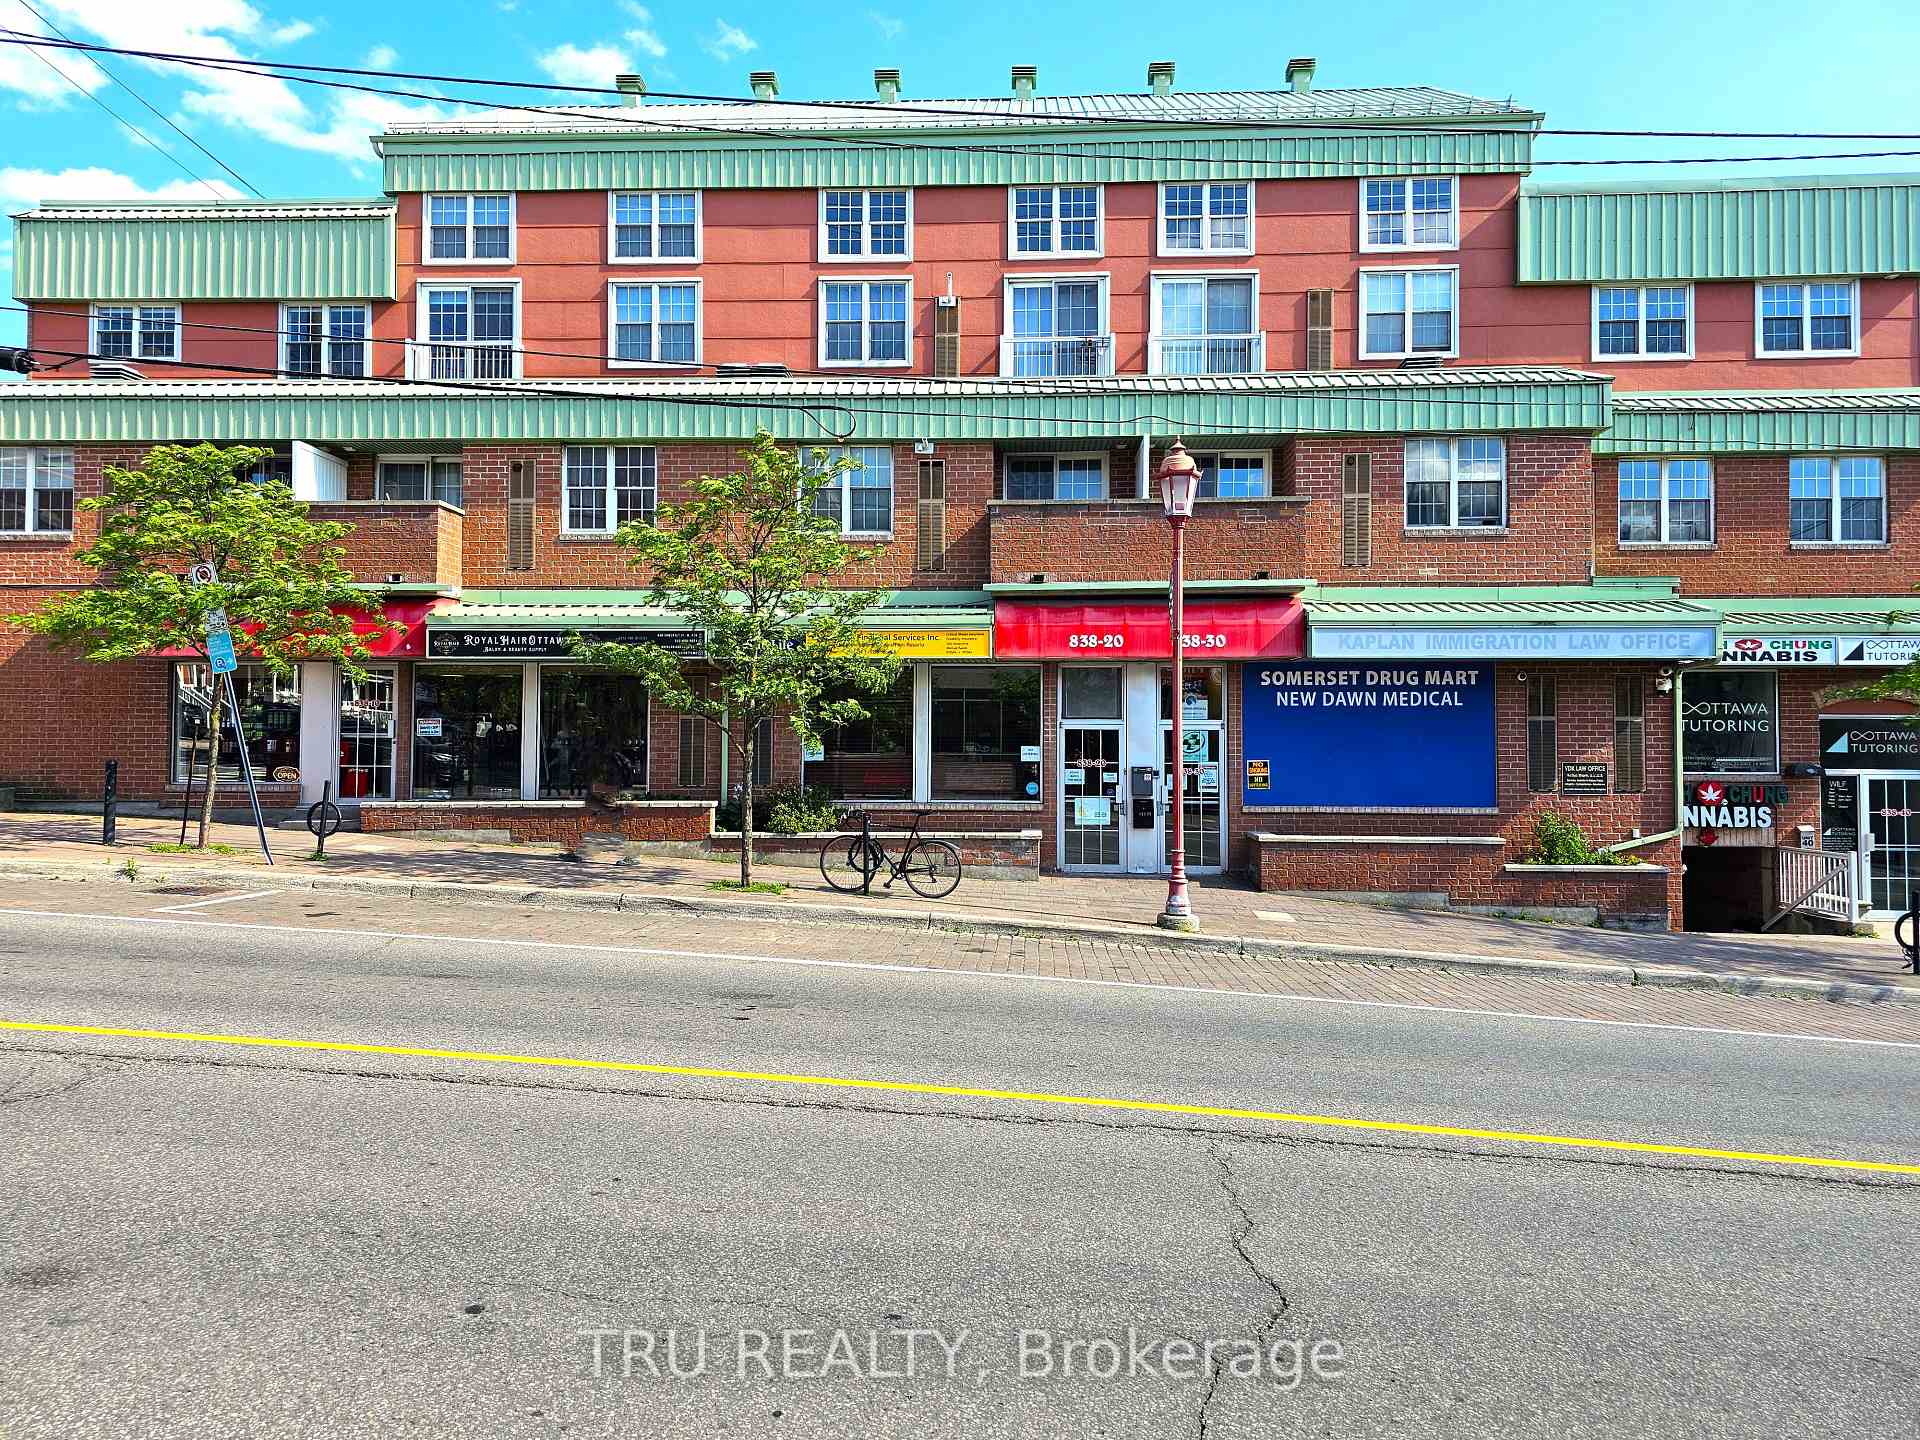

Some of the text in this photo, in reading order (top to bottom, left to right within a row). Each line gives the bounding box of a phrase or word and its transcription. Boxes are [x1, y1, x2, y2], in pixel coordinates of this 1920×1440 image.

[857, 633, 940, 641] Finaial Services Inc
[1068, 634, 1125, 648] 838-20
[1177, 634, 1227, 648] 38-30
[1339, 634, 1691, 650] KAPLAN IMMIGRATION LAW OFFICE
[1769, 640, 1832, 650] CHUNG
[1722, 651, 1818, 662] NNABIS
[1866, 652, 1920, 661] TUTORI
[1260, 670, 1479, 686] SOMERSET DRUG MART
[1276, 691, 1464, 707] NEW DAWN MEDICAL
[1682, 720, 1769, 732] TUTORING
[1850, 743, 1919, 754] TUTORING
[277, 771, 297, 780] OPEN
[1182, 767, 1206, 775] 38-30
[1729, 784, 1788, 803] CHUNG
[1683, 806, 1772, 828] NNABIS
[1802, 839, 1814, 847] 40
